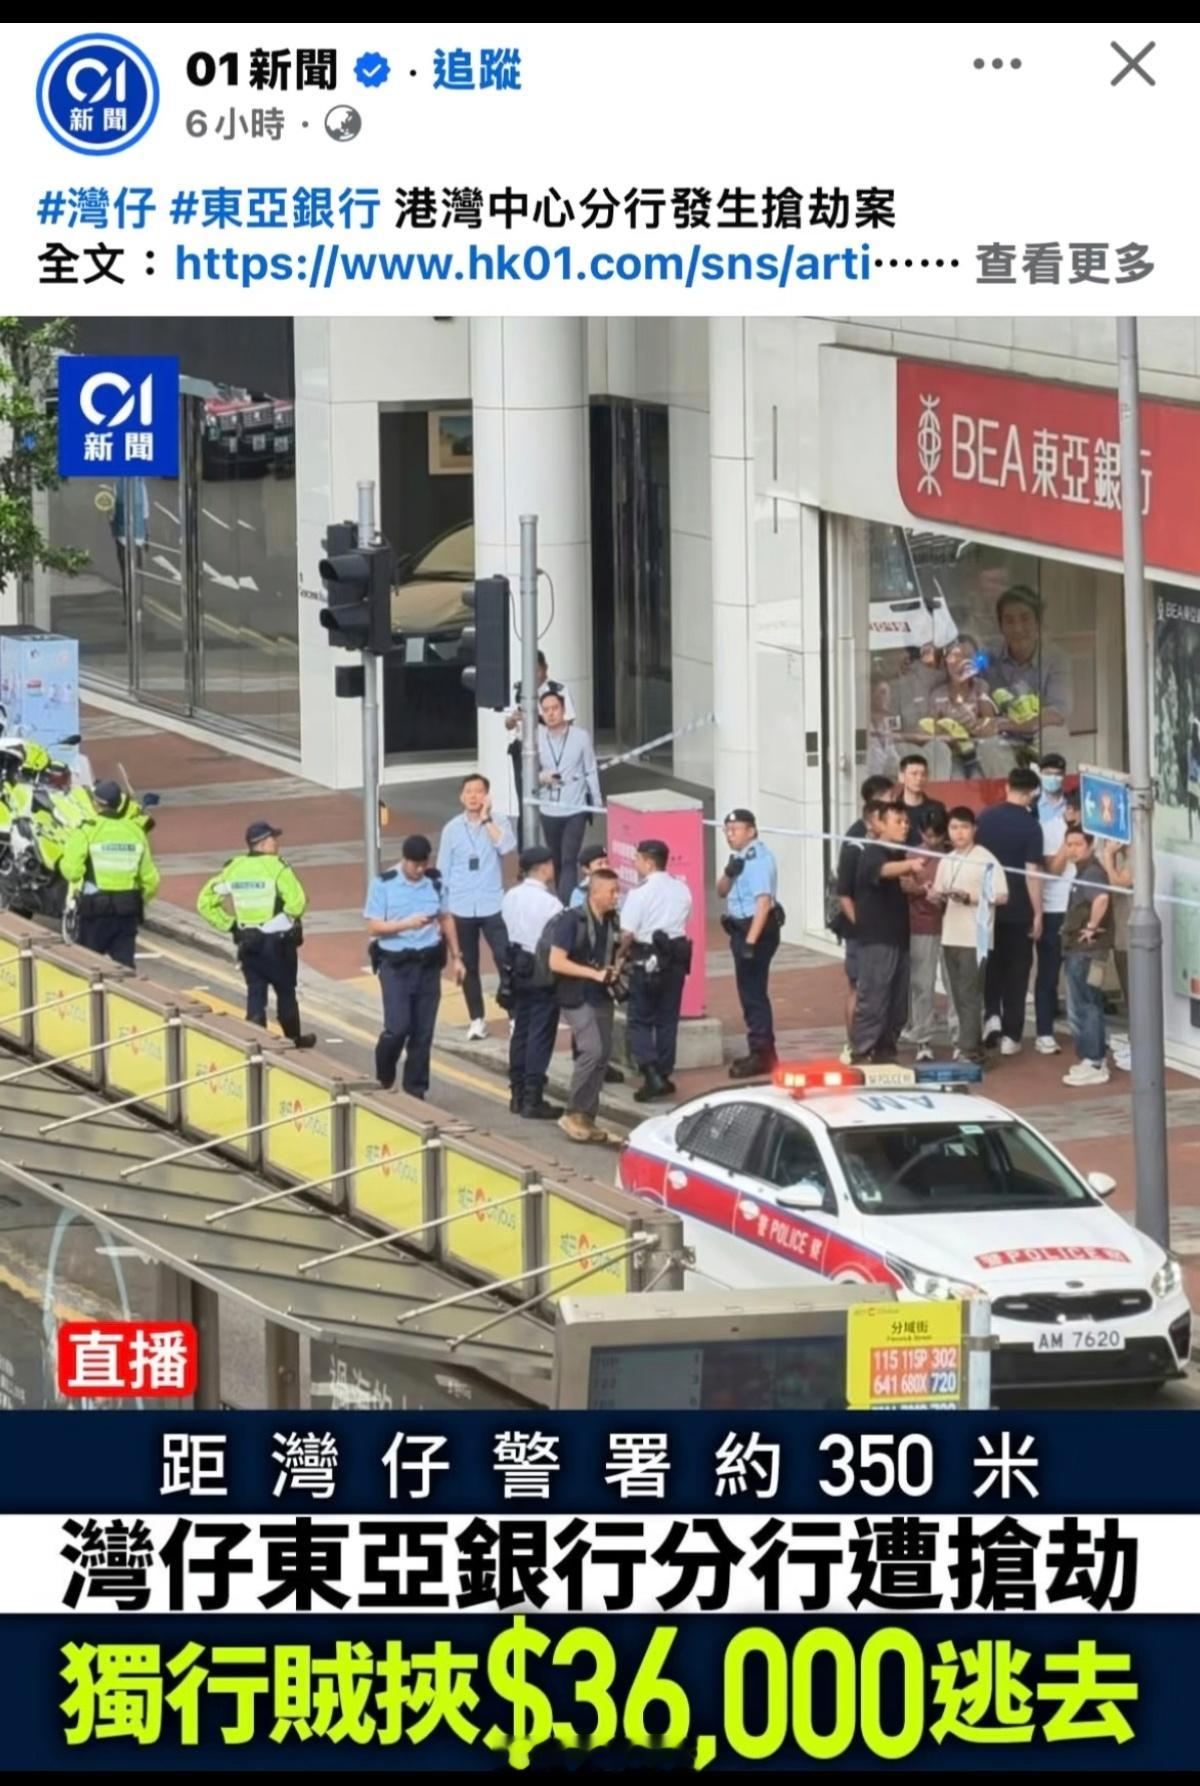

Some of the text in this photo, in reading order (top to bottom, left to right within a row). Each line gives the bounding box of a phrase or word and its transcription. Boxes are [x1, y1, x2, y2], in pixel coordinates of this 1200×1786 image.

[952, 413, 1026, 492] BEA
[769, 1219, 809, 1254] POLICE
[1006, 1247, 1103, 1265] POLICE
[1038, 1330, 1120, 1349] AM 7620
[874, 1347, 957, 1370] 115 115P 302
[873, 1371, 957, 1395] 641 680X 720
